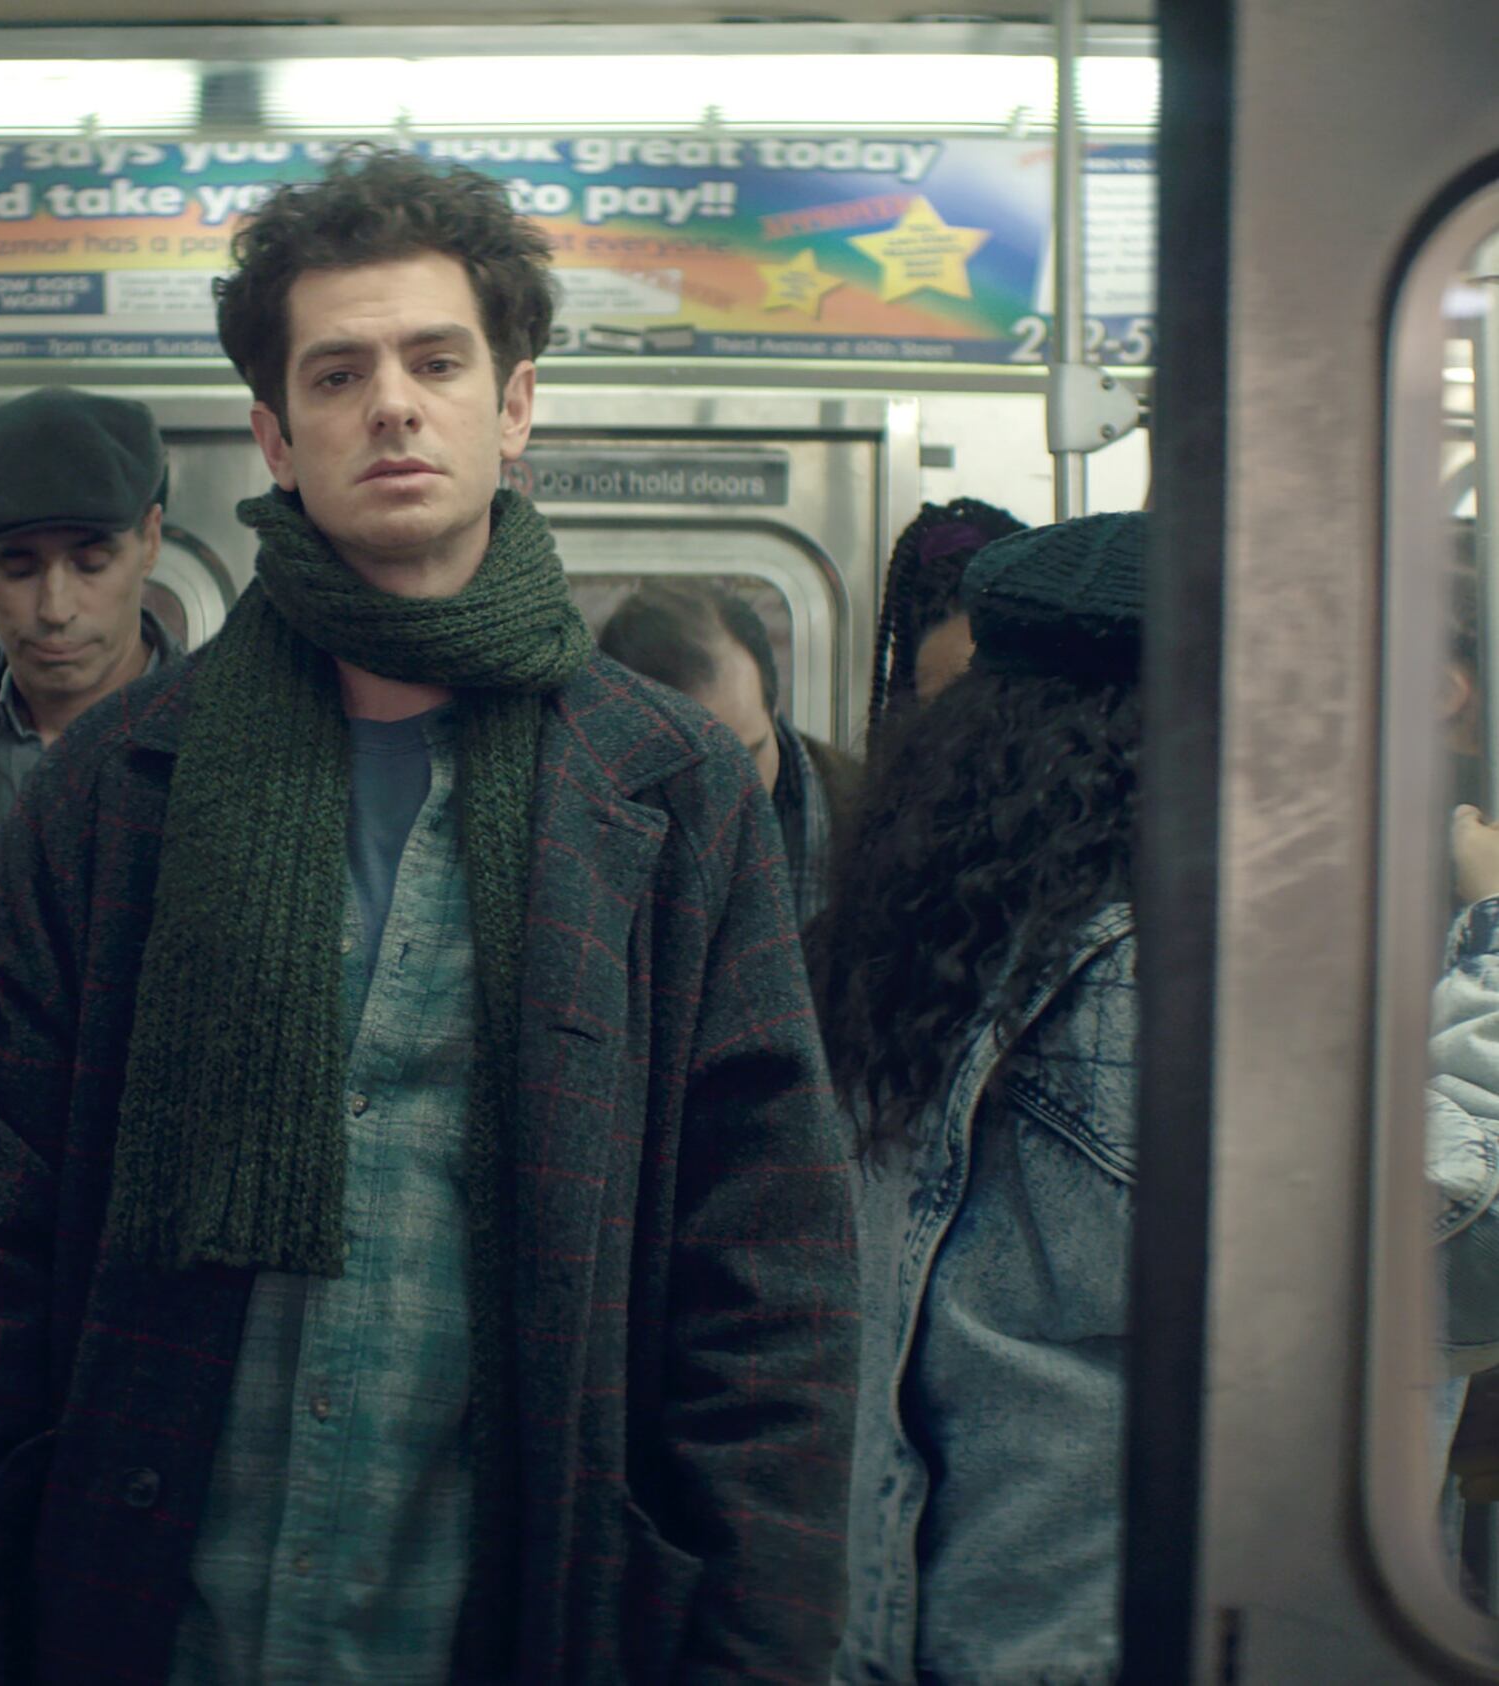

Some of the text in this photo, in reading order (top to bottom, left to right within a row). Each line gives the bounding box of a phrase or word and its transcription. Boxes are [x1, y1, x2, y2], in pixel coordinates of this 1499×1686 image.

[24, 140, 166, 174] says
[572, 138, 742, 174] great
[758, 138, 941, 181] today
[45, 178, 184, 219] take
[505, 177, 737, 225] to pay!!
[84, 233, 139, 254] has
[152, 237, 169, 253] a
[36, 276, 91, 292] DOES
[2, 292, 78, 309] WORK?
[539, 468, 766, 496] Do not hold doors
